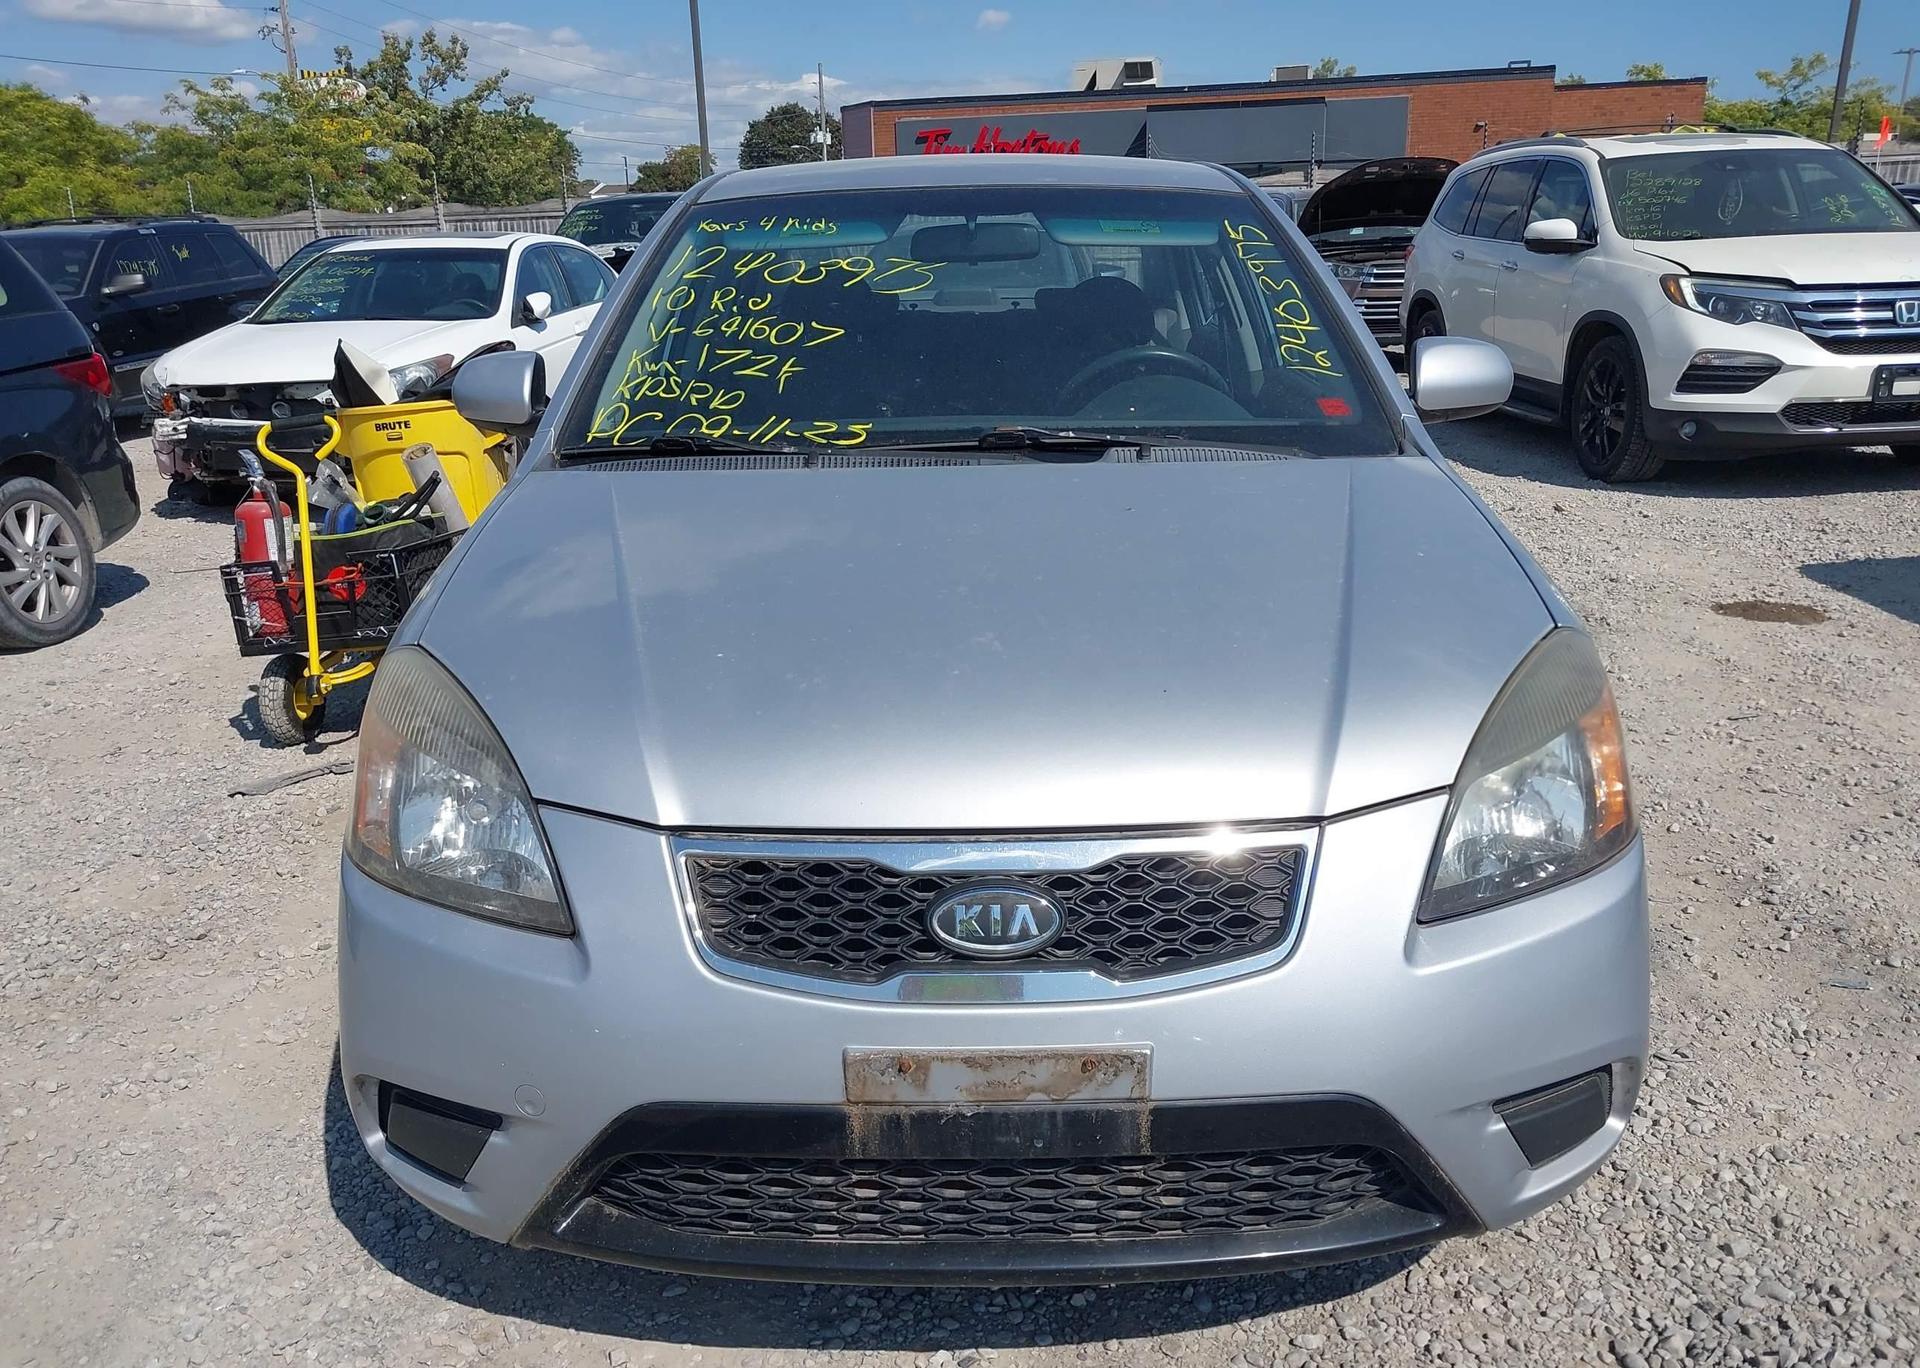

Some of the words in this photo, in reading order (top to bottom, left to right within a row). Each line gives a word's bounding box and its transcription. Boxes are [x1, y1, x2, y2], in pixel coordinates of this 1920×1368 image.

[760, 215, 777, 231] 4
[653, 285, 695, 311] 10
[1224, 219, 1343, 377] 12403975
[374, 420, 412, 432] BRUTE
[952, 903, 1041, 938] KIA
